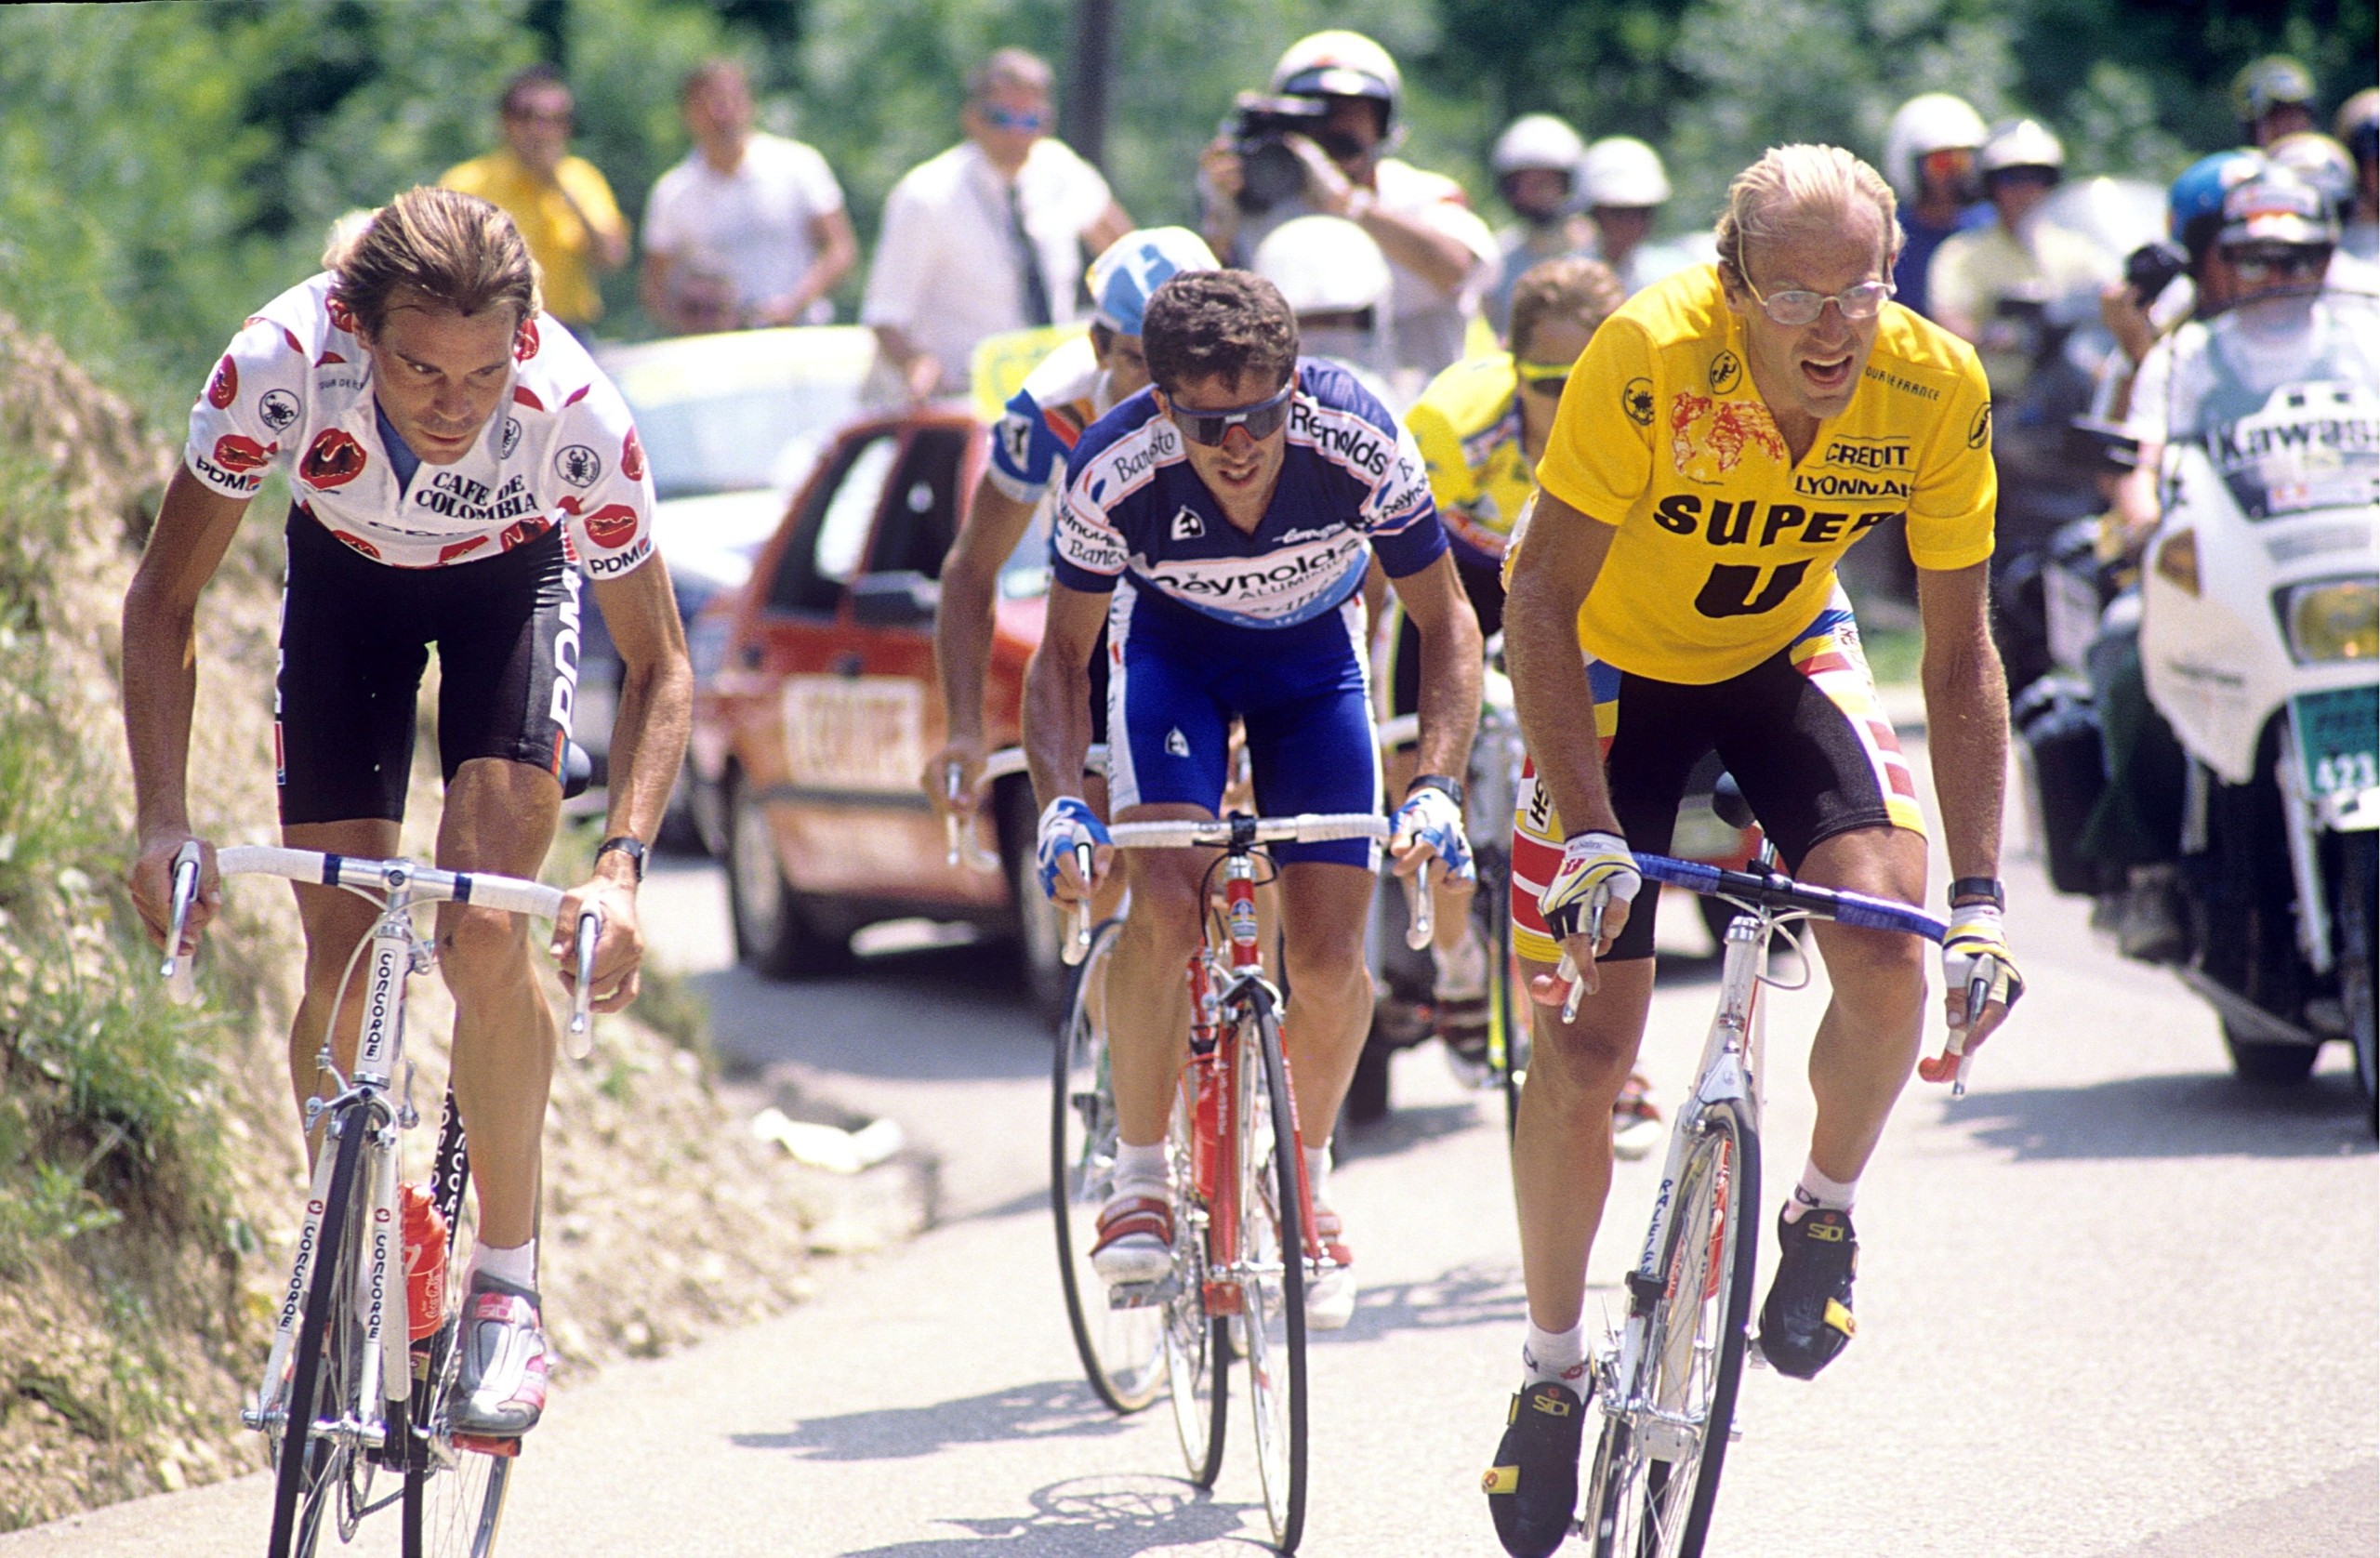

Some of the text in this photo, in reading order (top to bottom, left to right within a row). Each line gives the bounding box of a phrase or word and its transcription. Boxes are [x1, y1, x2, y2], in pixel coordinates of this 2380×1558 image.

[196, 456, 246, 490] PDM
[432, 472, 524, 506] CAFE DE
[1794, 475, 1912, 498] LYONNAI
[416, 493, 538, 520] COLOMBIA
[589, 548, 639, 574] PDM
[1694, 558, 1816, 619] U
[549, 570, 582, 740] PDM
[365, 953, 393, 1057] CONCORDE
[1806, 1222, 1845, 1242] SIDI
[280, 1226, 316, 1328] CONCORDE
[368, 1235, 387, 1340] CONCORDE
[1532, 1394, 1571, 1418] SIDI
